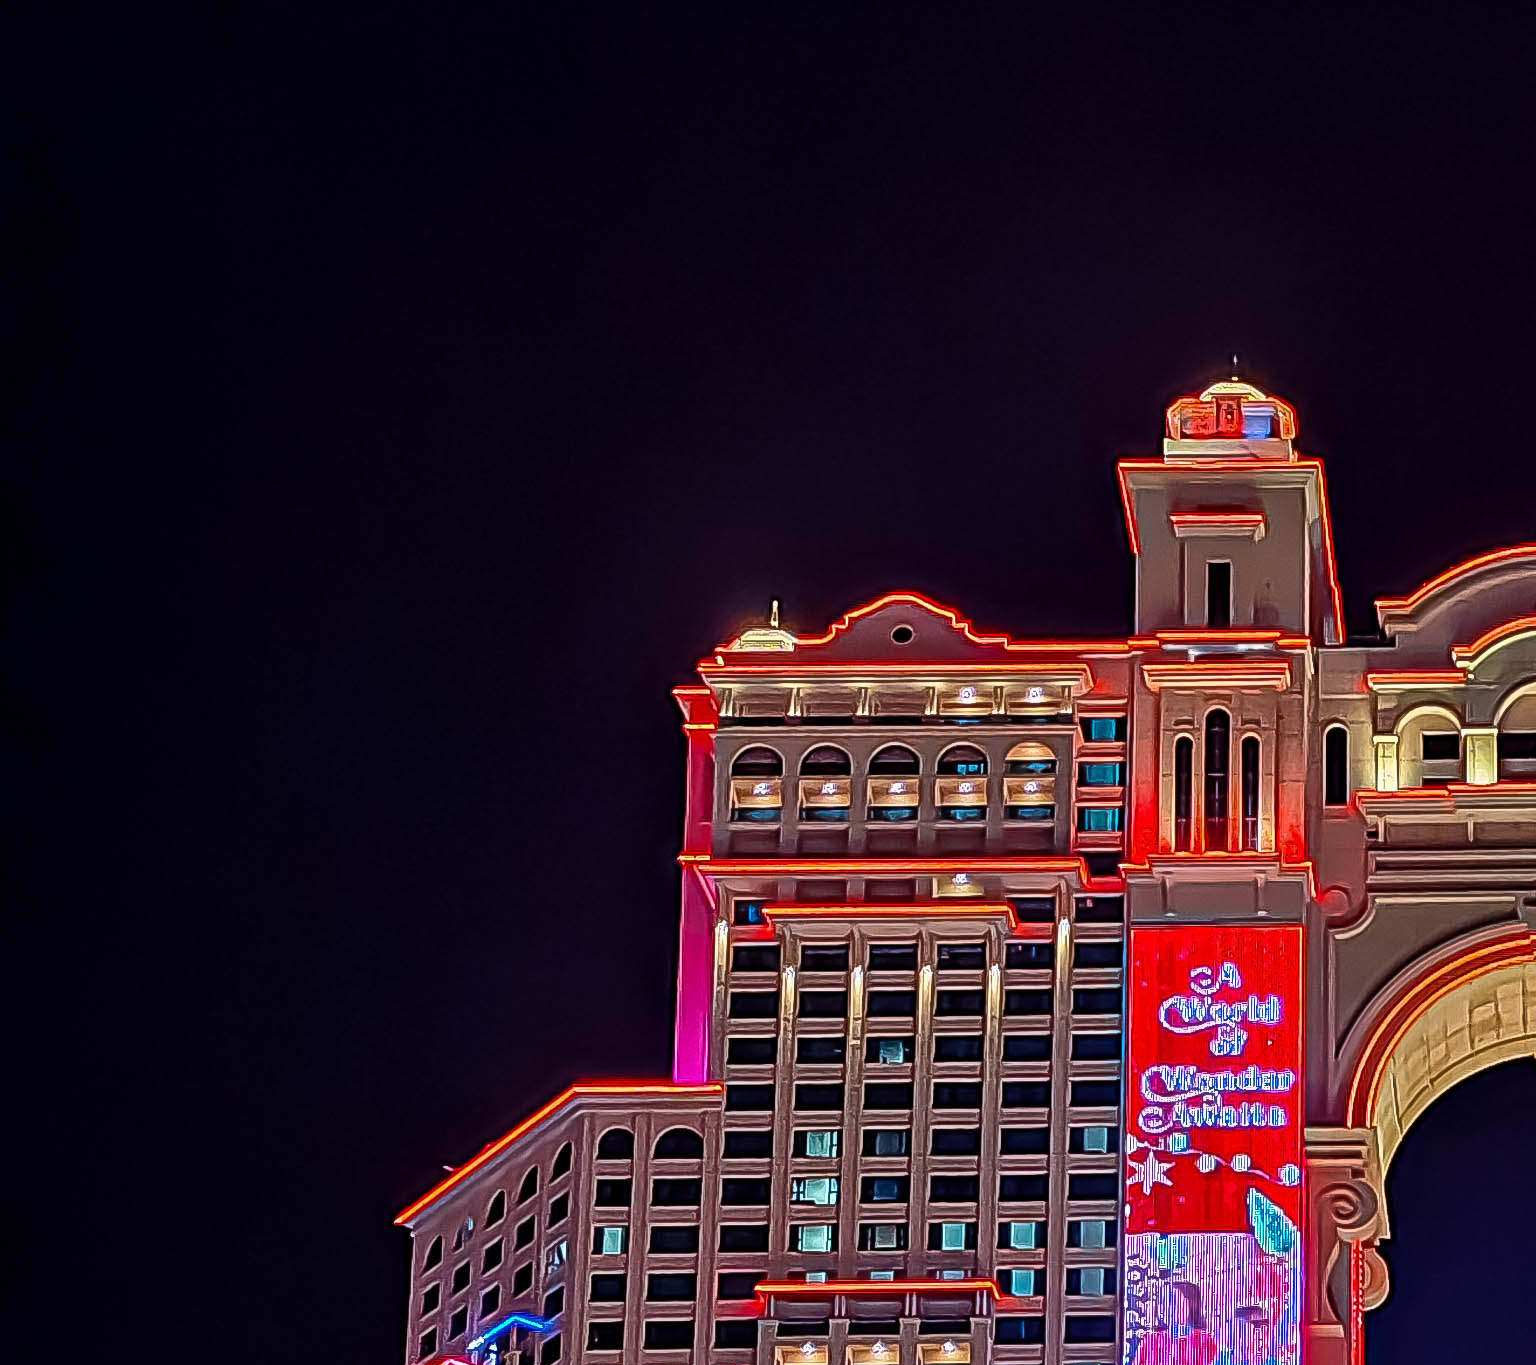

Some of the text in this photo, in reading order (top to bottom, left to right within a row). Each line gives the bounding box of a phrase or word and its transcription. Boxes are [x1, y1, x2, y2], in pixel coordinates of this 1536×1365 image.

[1159, 995, 1283, 1034] World
[1209, 1024, 1248, 1056] of
[1141, 1064, 1295, 1102] Wonder
